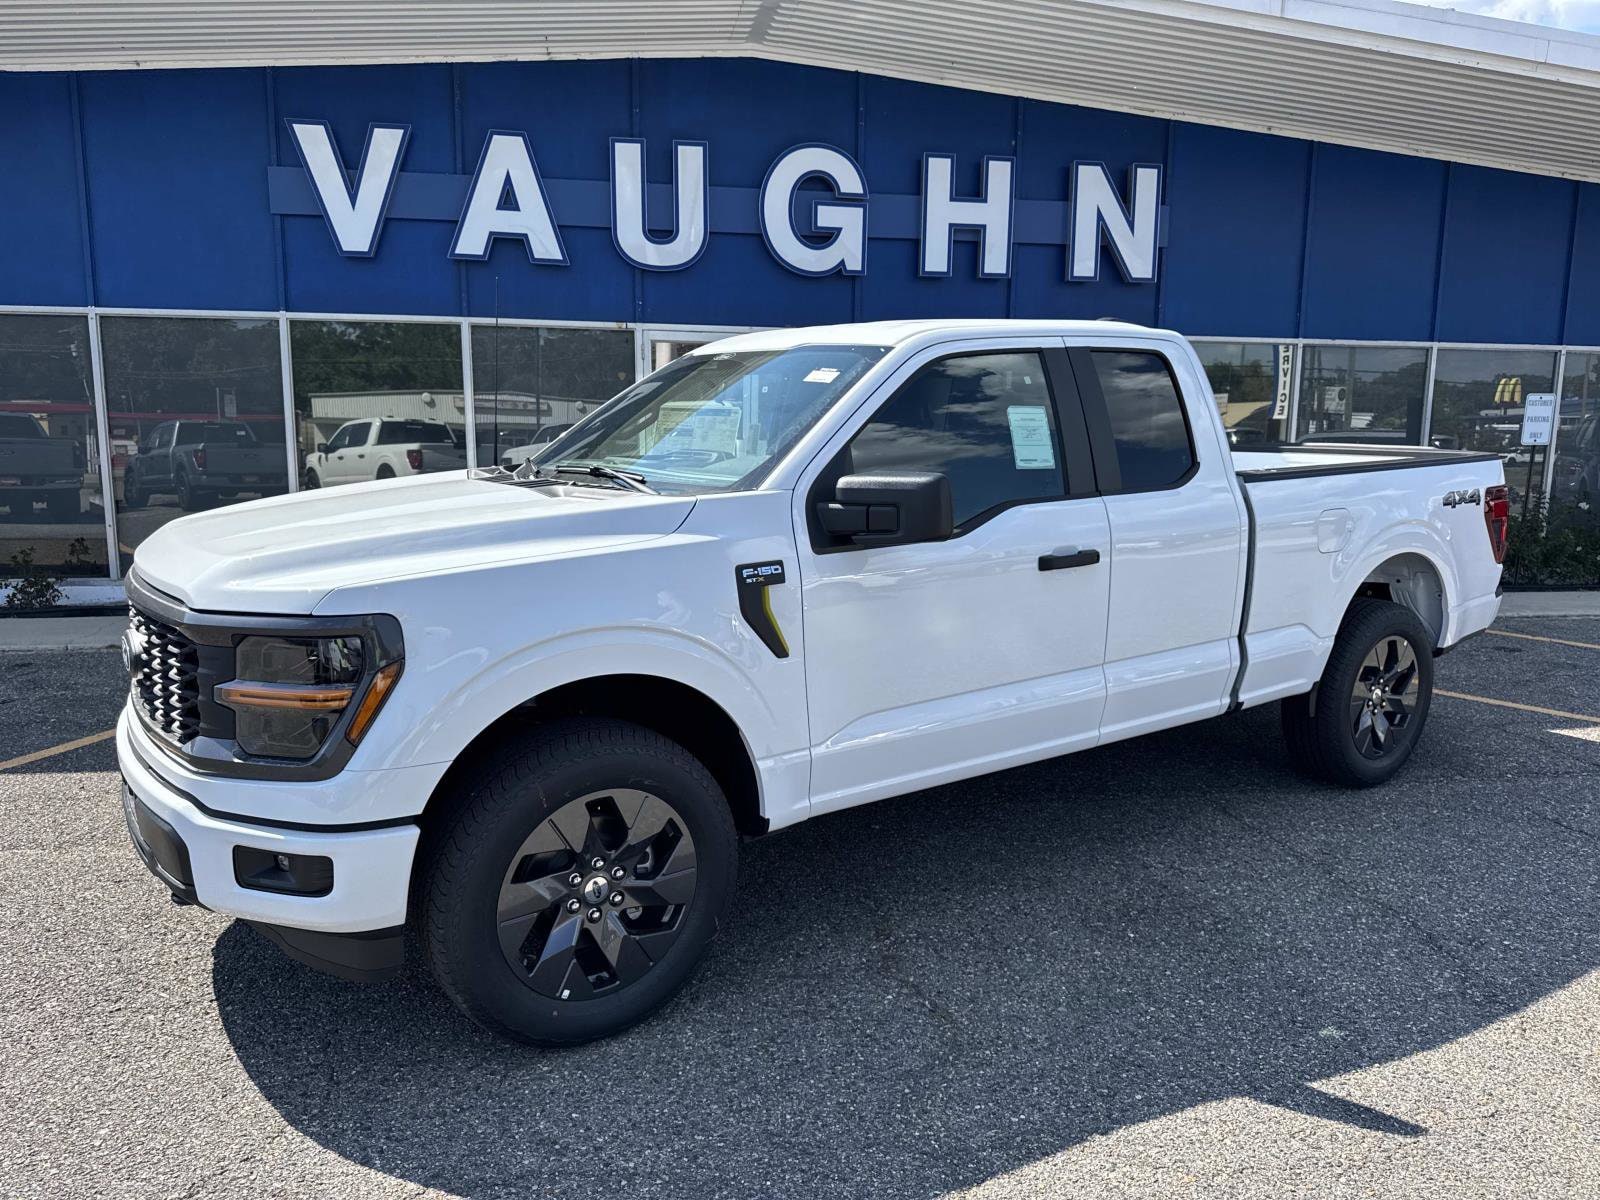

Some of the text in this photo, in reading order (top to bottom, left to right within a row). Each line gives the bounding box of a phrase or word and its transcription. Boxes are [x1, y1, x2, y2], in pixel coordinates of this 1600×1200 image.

[289, 121, 1162, 282] VAUGHN
[1528, 399, 1553, 407] CUSTOMER
[1526, 415, 1550, 423] PARKING
[1529, 431, 1543, 439] ONLY
[742, 565, 782, 578] F-150
[745, 576, 765, 584] STX
